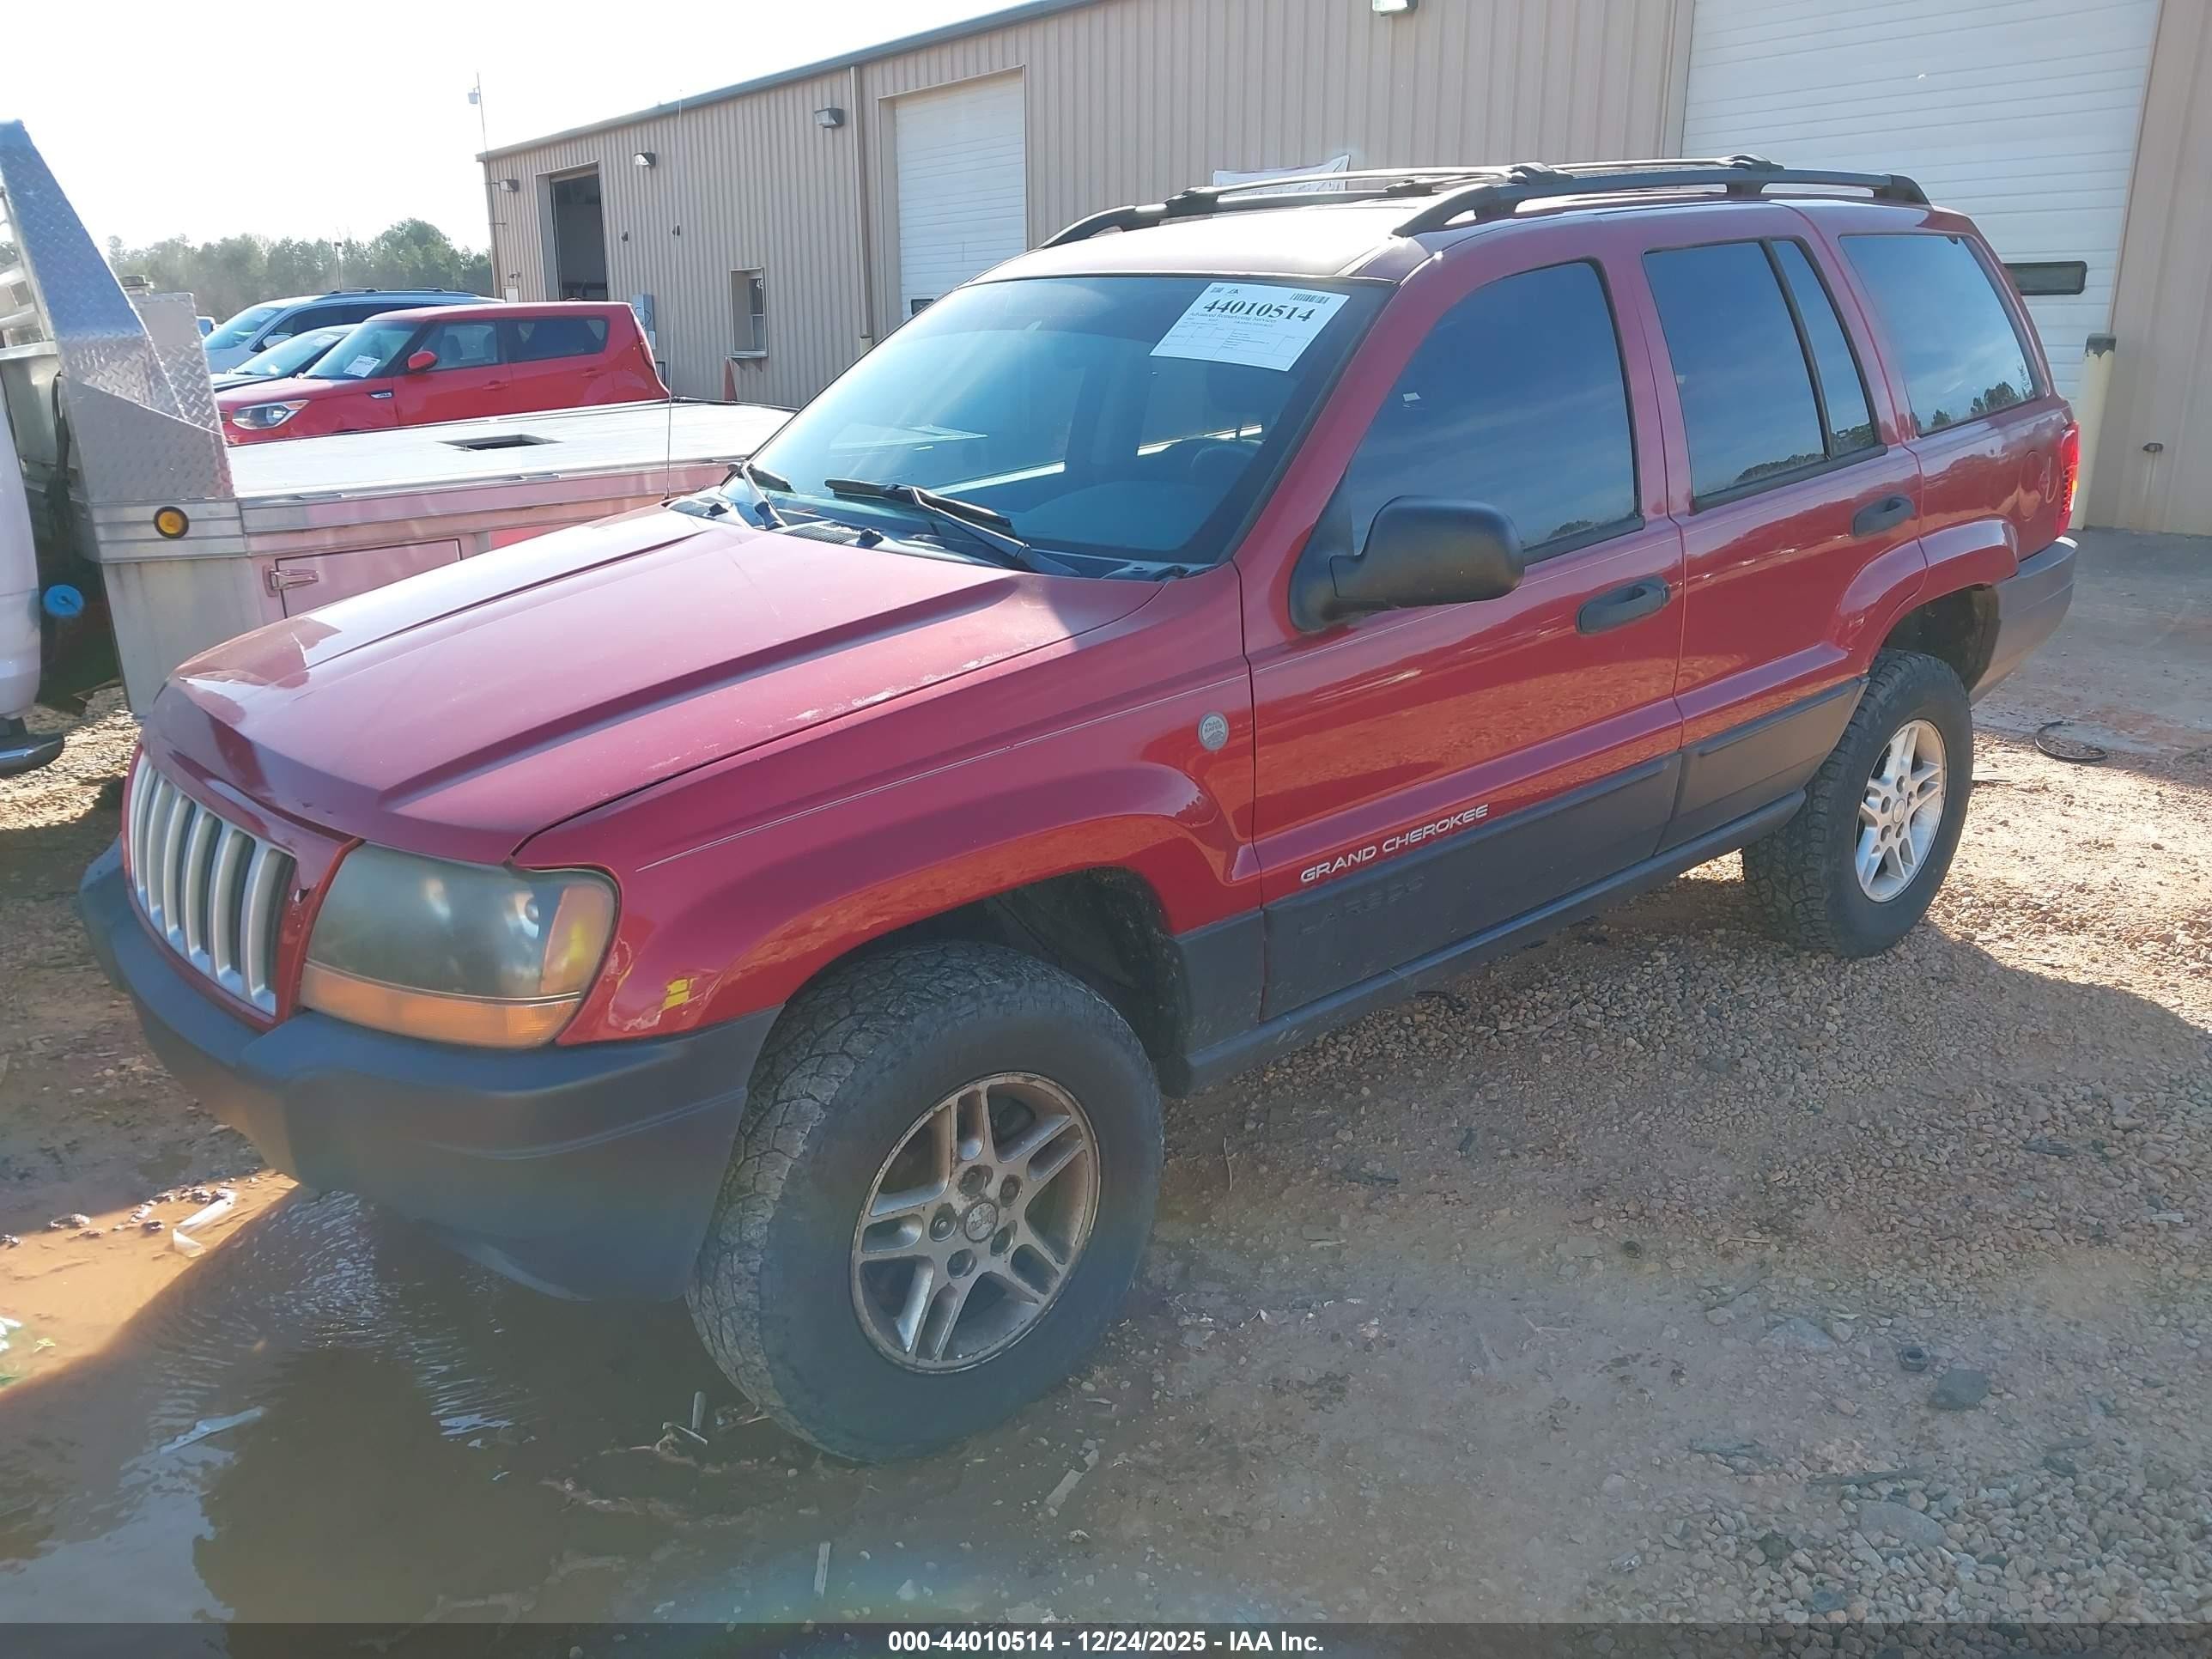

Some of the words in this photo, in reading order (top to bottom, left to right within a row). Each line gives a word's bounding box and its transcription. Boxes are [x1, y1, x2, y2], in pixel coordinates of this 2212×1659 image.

[1203, 299, 1316, 322] 44010514
[1300, 846, 1377, 884] GRAND
[1382, 804, 1489, 853] CHEROKEE
